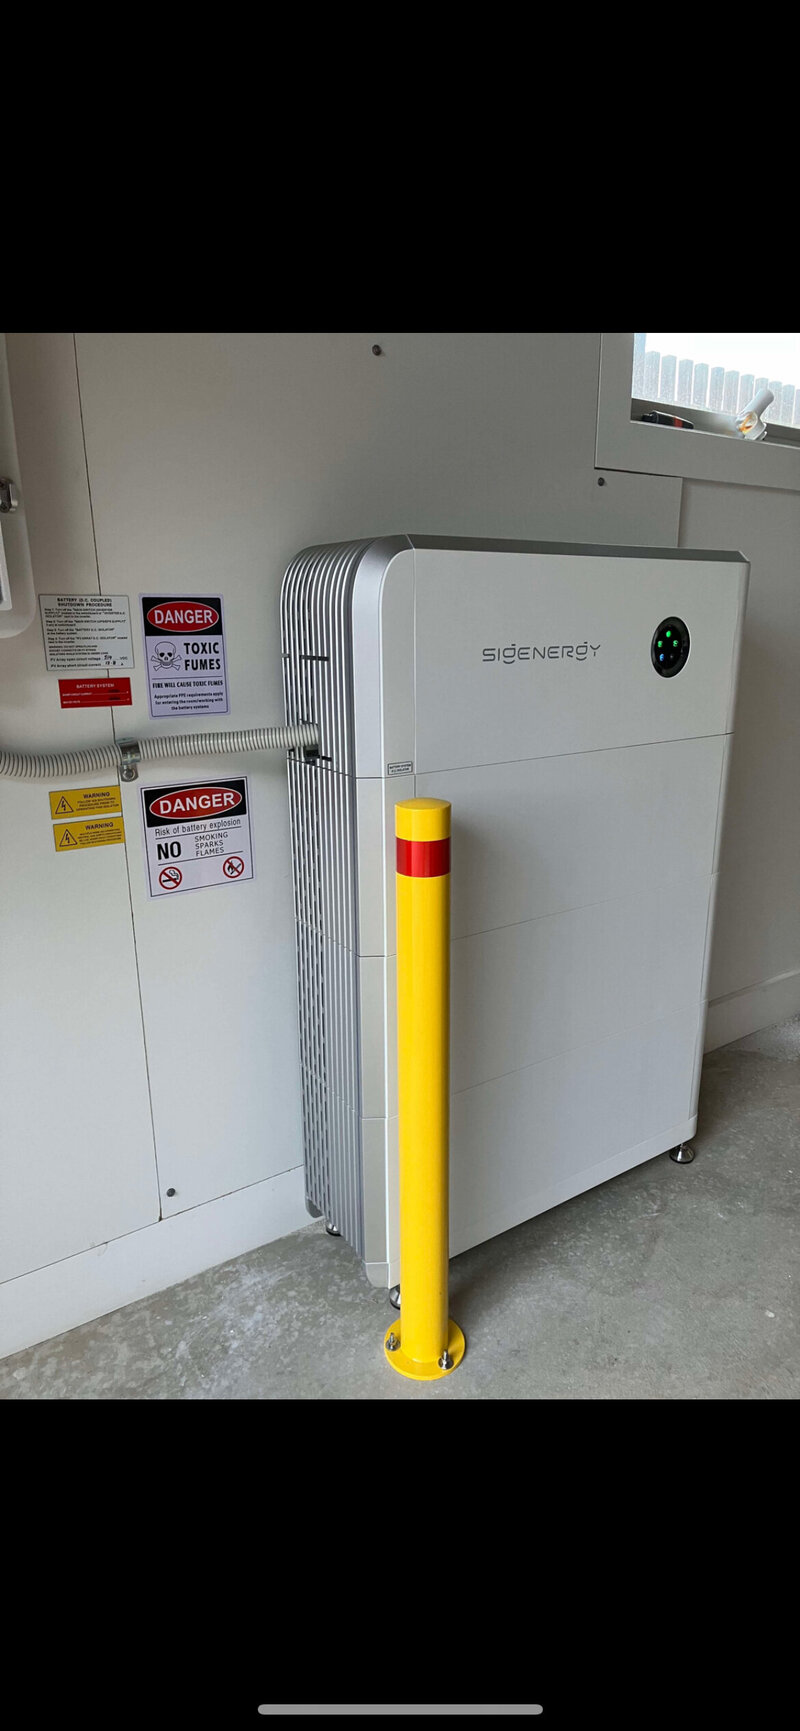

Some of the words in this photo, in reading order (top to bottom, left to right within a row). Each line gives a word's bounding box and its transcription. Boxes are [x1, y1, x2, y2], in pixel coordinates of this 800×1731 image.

[154, 609, 214, 624] DANGER
[184, 642, 219, 654] TOXIC
[184, 659, 220, 671] FUMES
[160, 792, 235, 815] DANGER
[85, 822, 114, 831] WARNING
[155, 828, 171, 837] Risk
[182, 824, 207, 834] battery
[209, 818, 241, 830] explosion
[194, 832, 228, 842] SMOKING
[156, 841, 182, 861] NO
[195, 840, 224, 850] SPARKS
[196, 847, 225, 857] FLAMES
